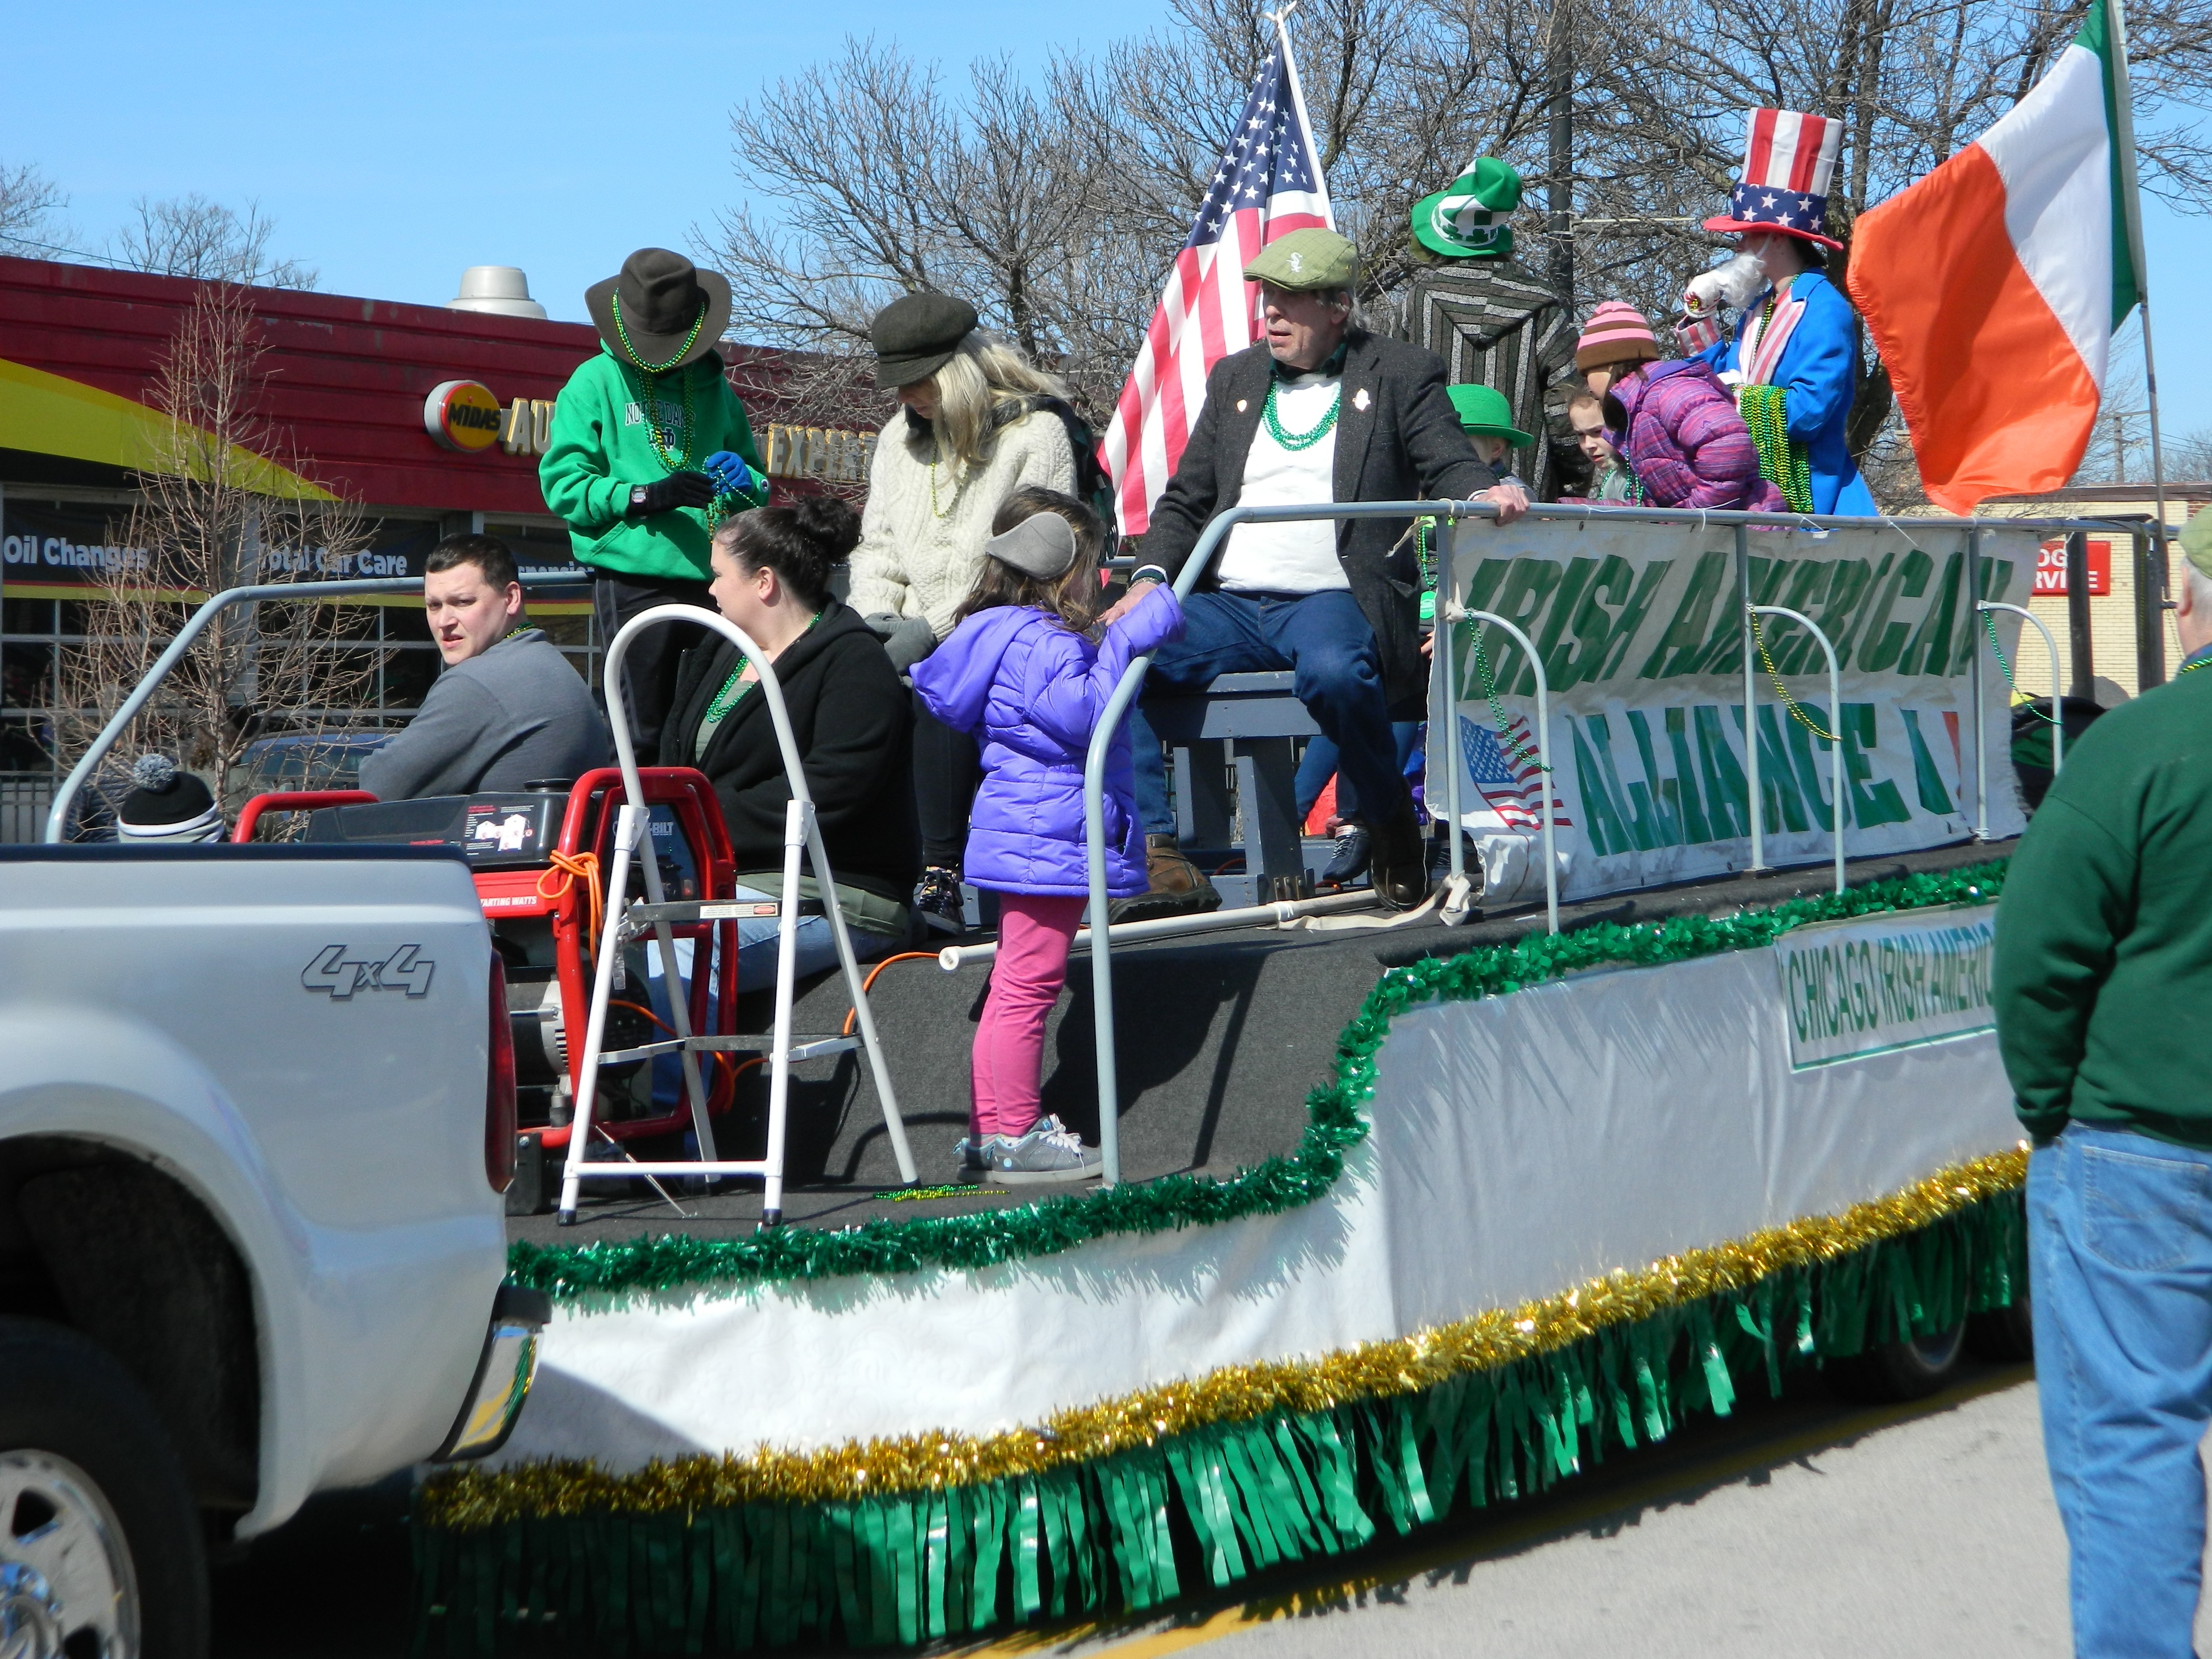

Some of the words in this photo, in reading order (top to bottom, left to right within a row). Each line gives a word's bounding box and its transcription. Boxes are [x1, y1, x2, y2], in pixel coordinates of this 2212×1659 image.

[448, 402, 501, 431] MIDAS
[3, 535, 38, 564] Oil
[44, 537, 150, 573] Changes
[315, 546, 352, 573] Car
[357, 548, 408, 576] Care
[1452, 555, 1676, 701] IRISH
[1566, 703, 1911, 857] ALLIANCE
[512, 896, 537, 906] WATTS
[301, 944, 435, 998] 4x4
[1789, 939, 1878, 1043] CHICAGO
[1878, 933, 1928, 1025] IRISH
